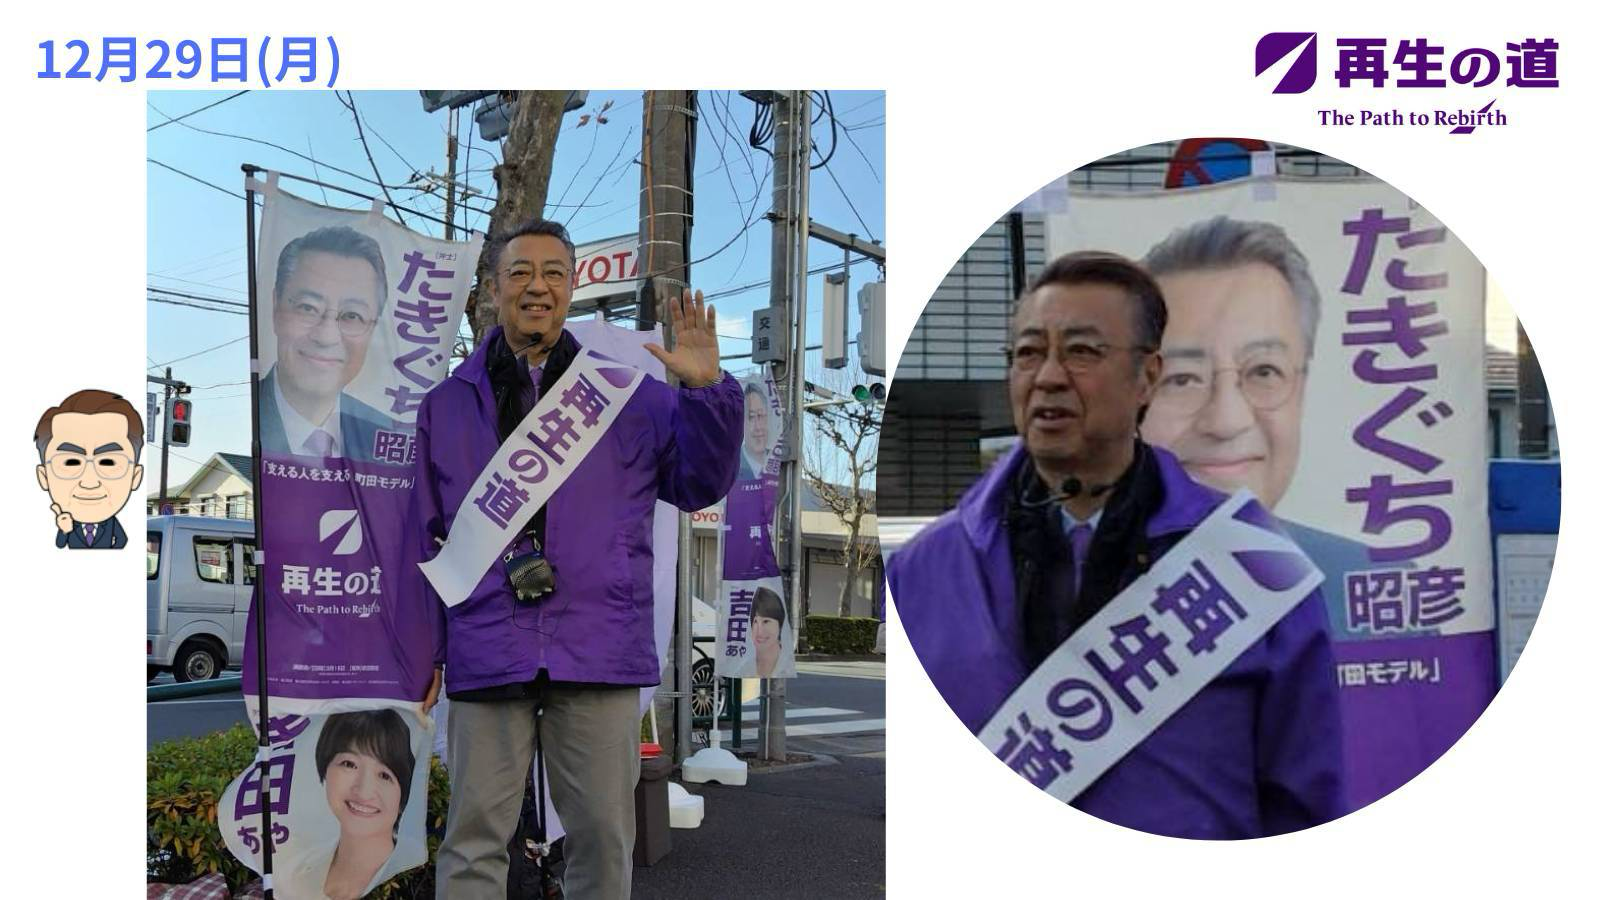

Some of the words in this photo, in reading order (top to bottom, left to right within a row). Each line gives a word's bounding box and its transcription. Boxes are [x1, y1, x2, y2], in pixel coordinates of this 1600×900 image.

[1340, 207, 1455, 563] たきぐち
[473, 372, 611, 531] 再生の道
[296, 603, 315, 614] The
[317, 605, 339, 615] Path
[341, 604, 351, 614] to
[726, 589, 754, 643] 吉田
[1346, 566, 1466, 630] 昭彦
[995, 558, 1249, 792] 再生の道
